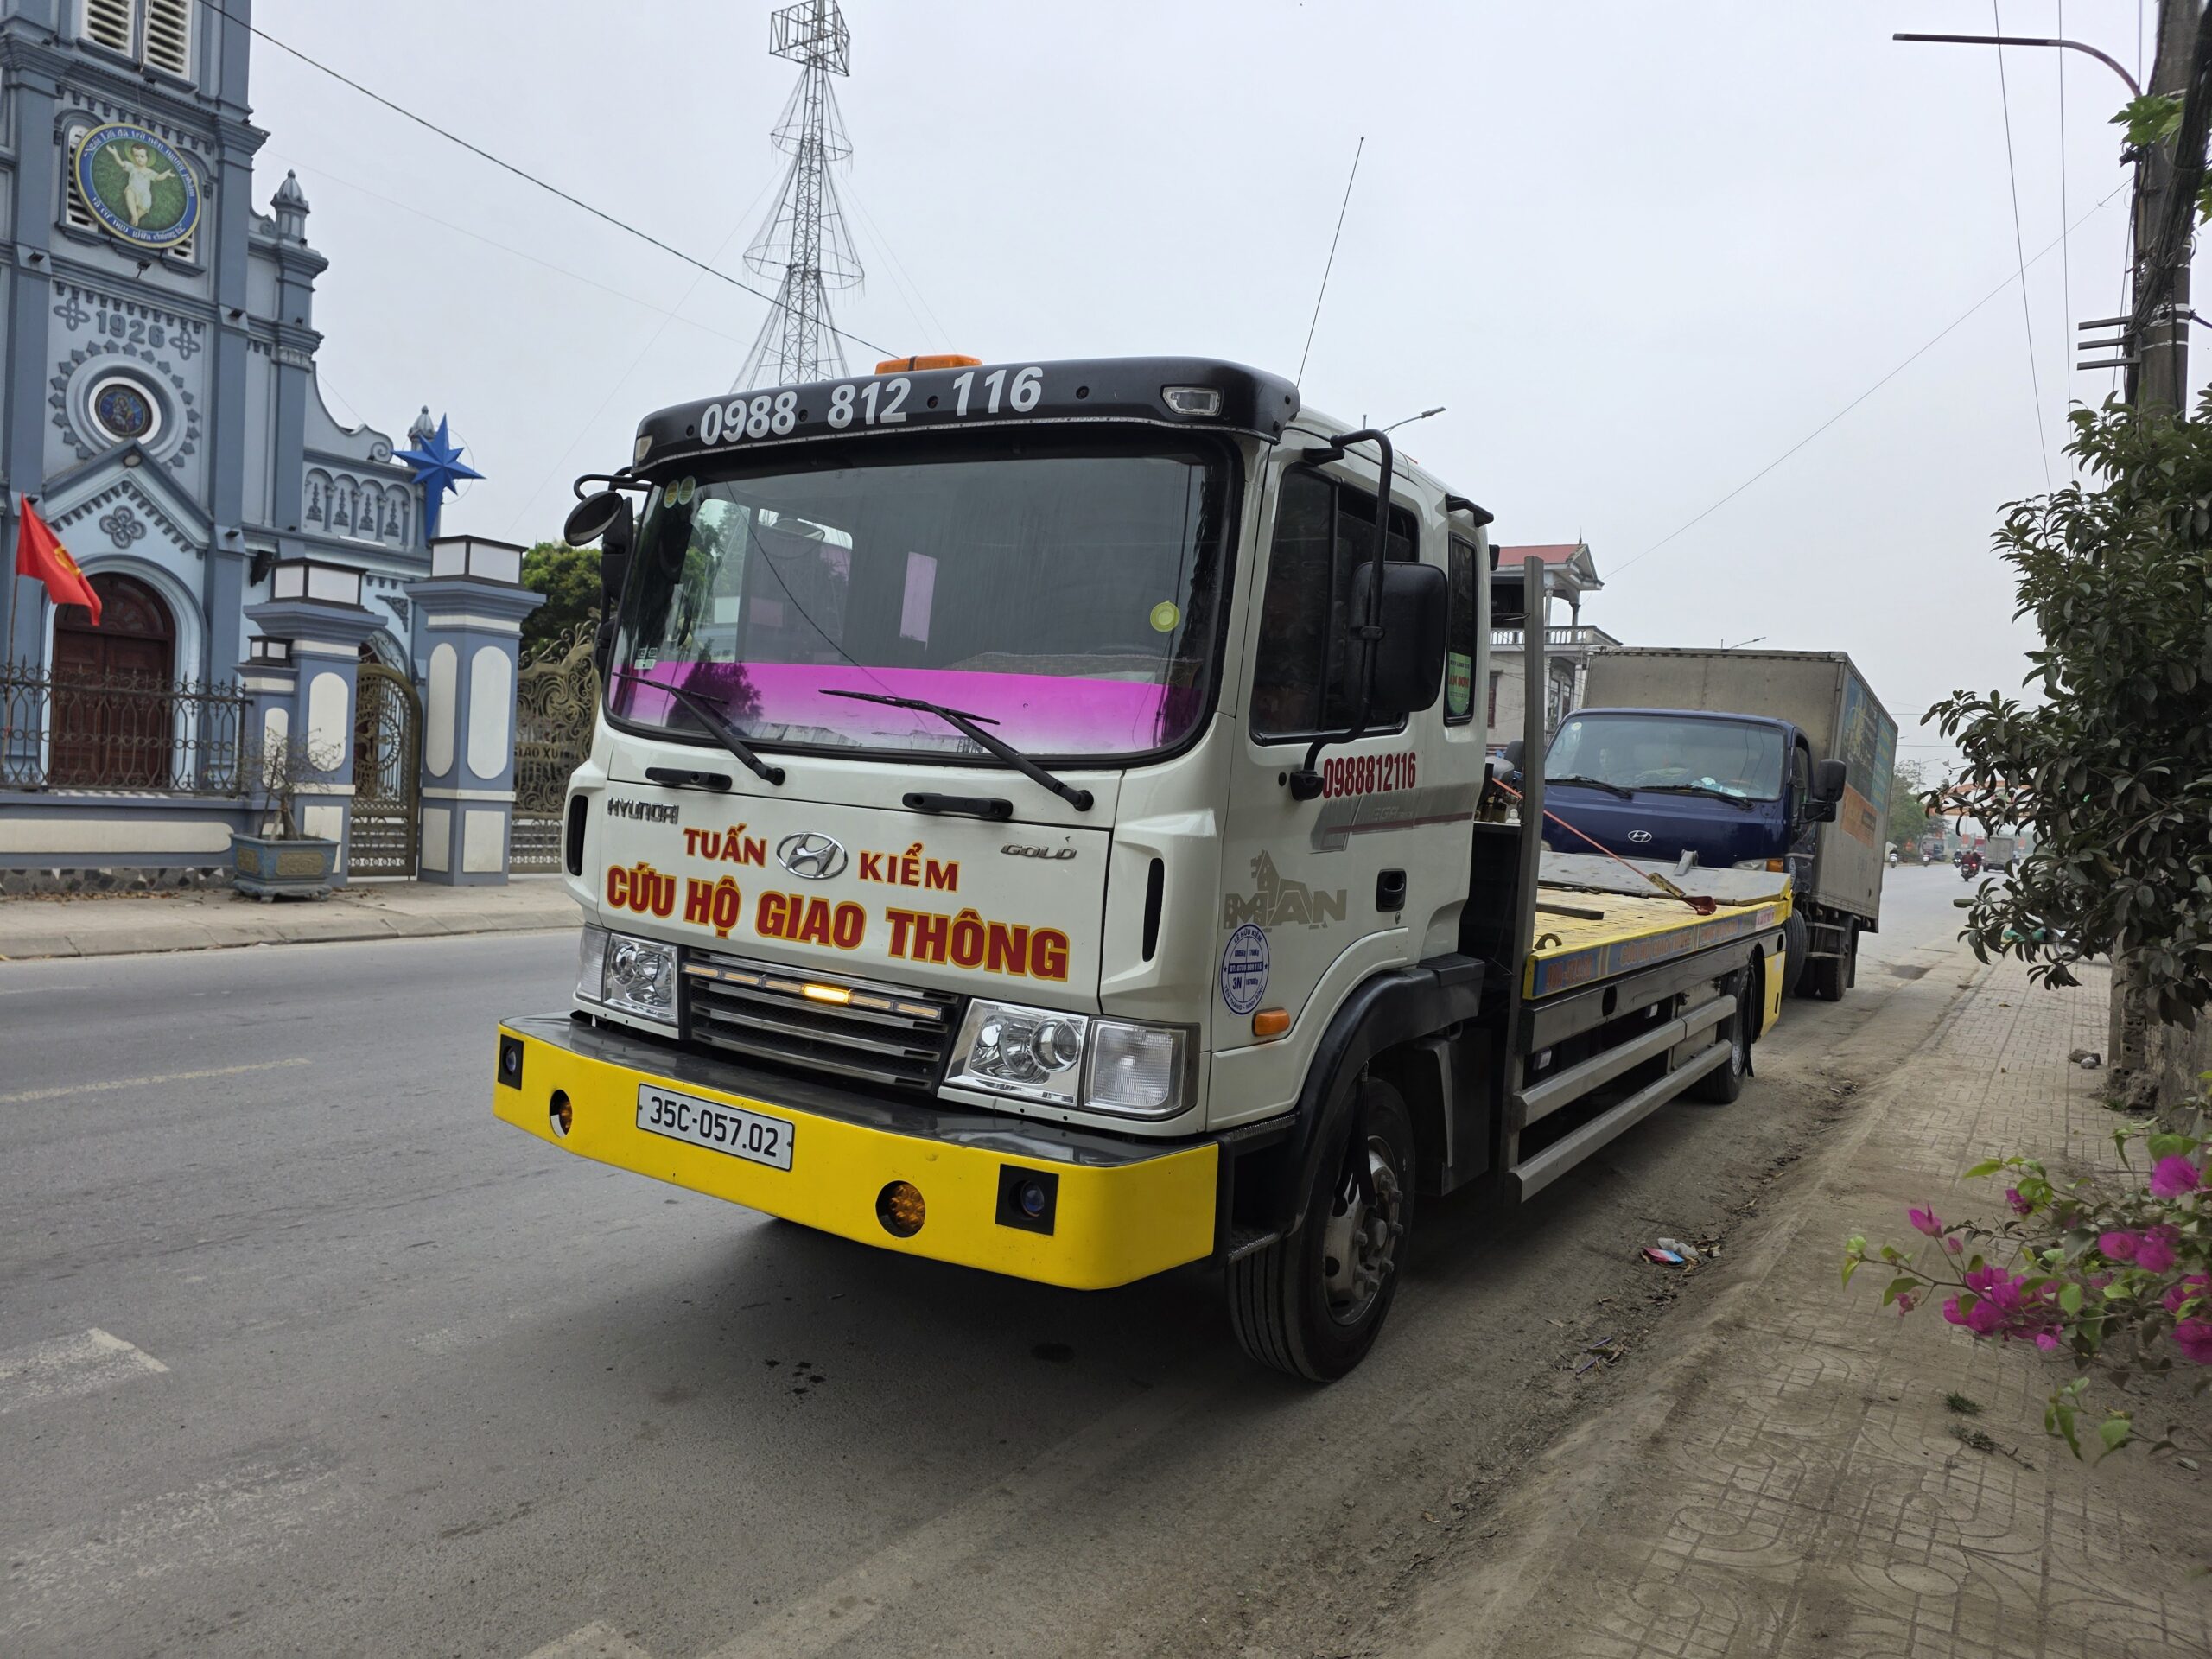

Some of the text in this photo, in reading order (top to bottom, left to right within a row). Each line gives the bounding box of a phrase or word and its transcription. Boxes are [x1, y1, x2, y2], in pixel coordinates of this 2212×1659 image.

[96, 310, 165, 348] 1926
[700, 366, 1044, 446] 0988 812 116
[1323, 752, 1416, 799] 0988812116
[607, 797, 680, 825] HYUNDAI
[683, 823, 960, 893] TUẤN KIỂM
[1001, 842, 1077, 861] GOLD
[607, 861, 1070, 982] CỨU HỘ GIAO THÔNG
[1223, 889, 1347, 930] MAN
[1232, 976, 1242, 990] 3N
[650, 1096, 779, 1157] 35C-057.02
